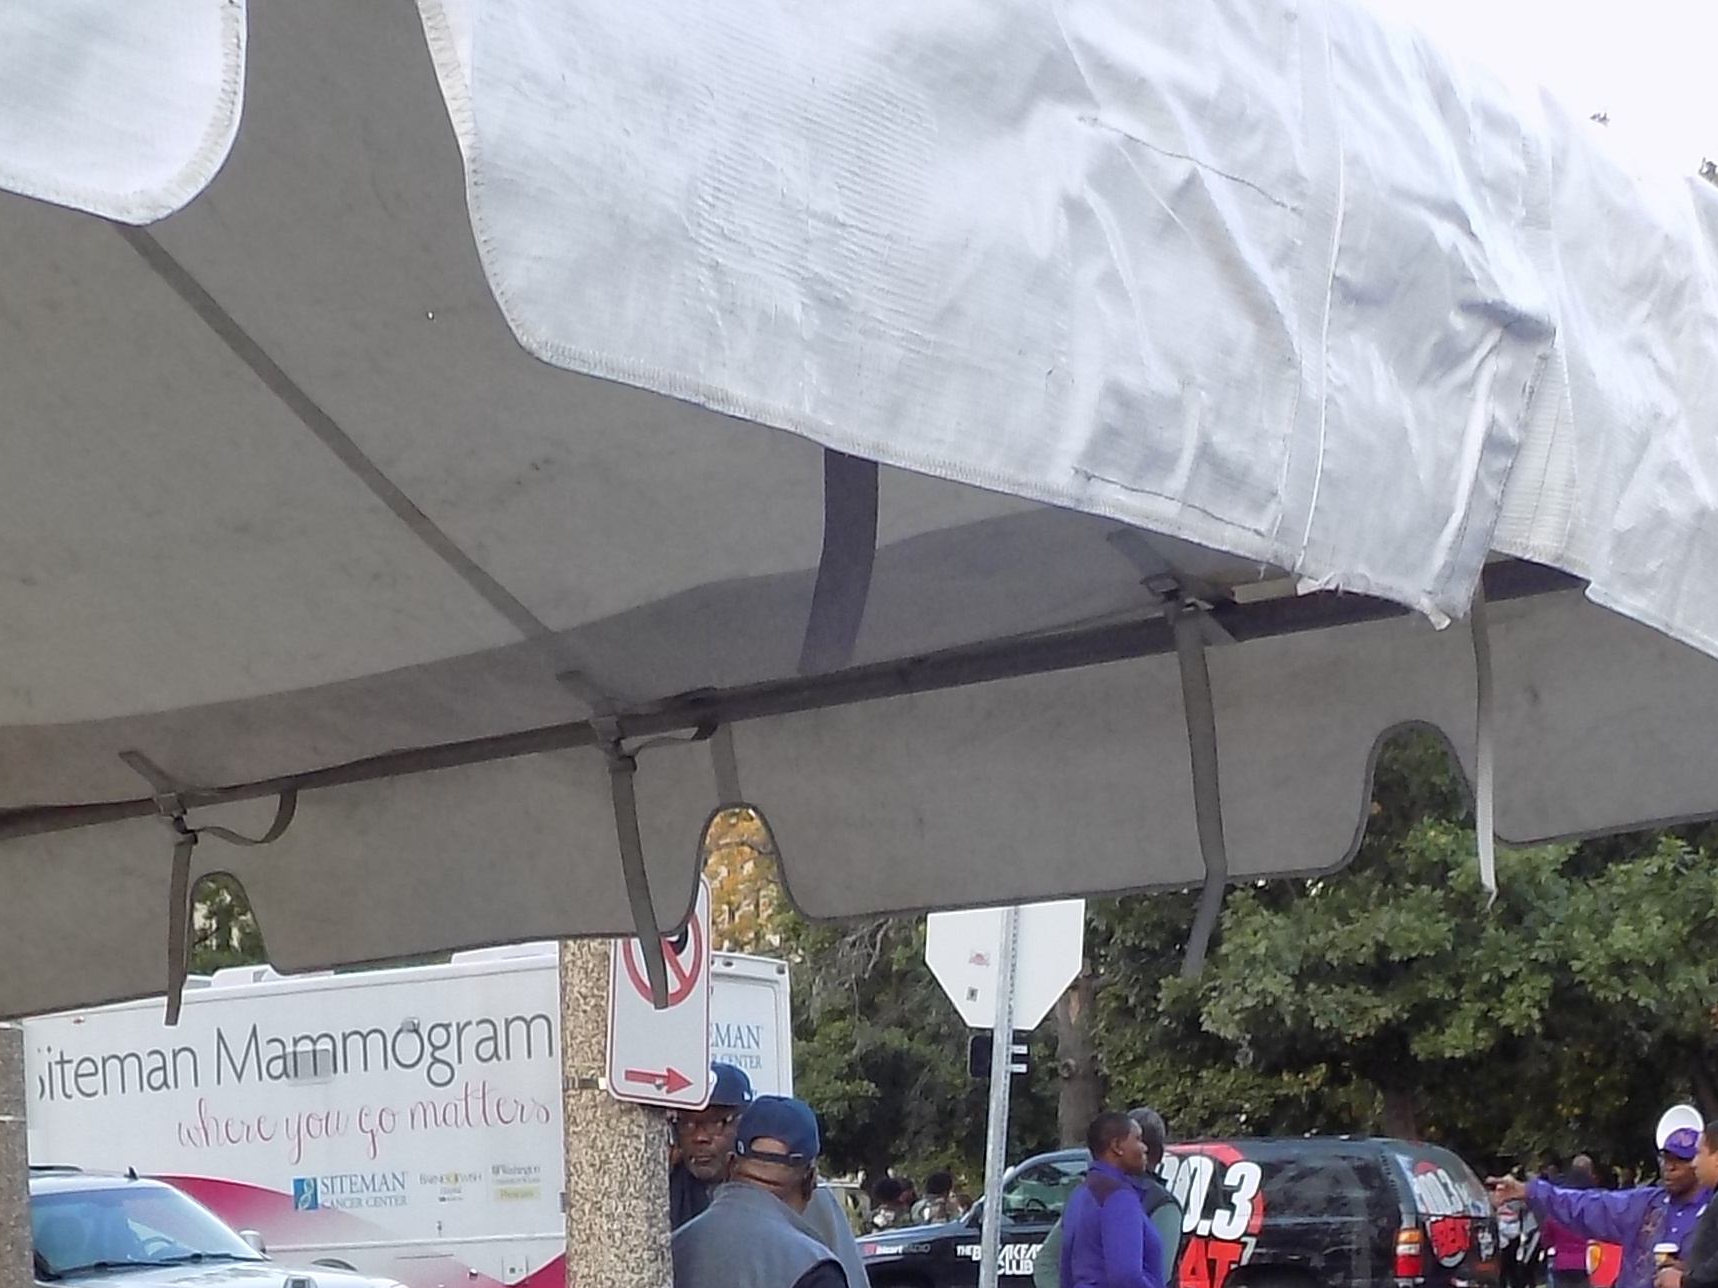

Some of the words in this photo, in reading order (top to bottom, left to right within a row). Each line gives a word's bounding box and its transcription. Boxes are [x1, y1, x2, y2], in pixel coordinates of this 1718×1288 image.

[214, 1010, 554, 1088] Mammogram
[177, 1098, 277, 1148] where
[285, 1110, 351, 1165] you
[356, 1104, 398, 1161] go
[410, 1080, 553, 1132] matters
[320, 1171, 406, 1195] SITEMAN
[320, 1196, 363, 1209] CANCER
[366, 1194, 407, 1208] CENTER
